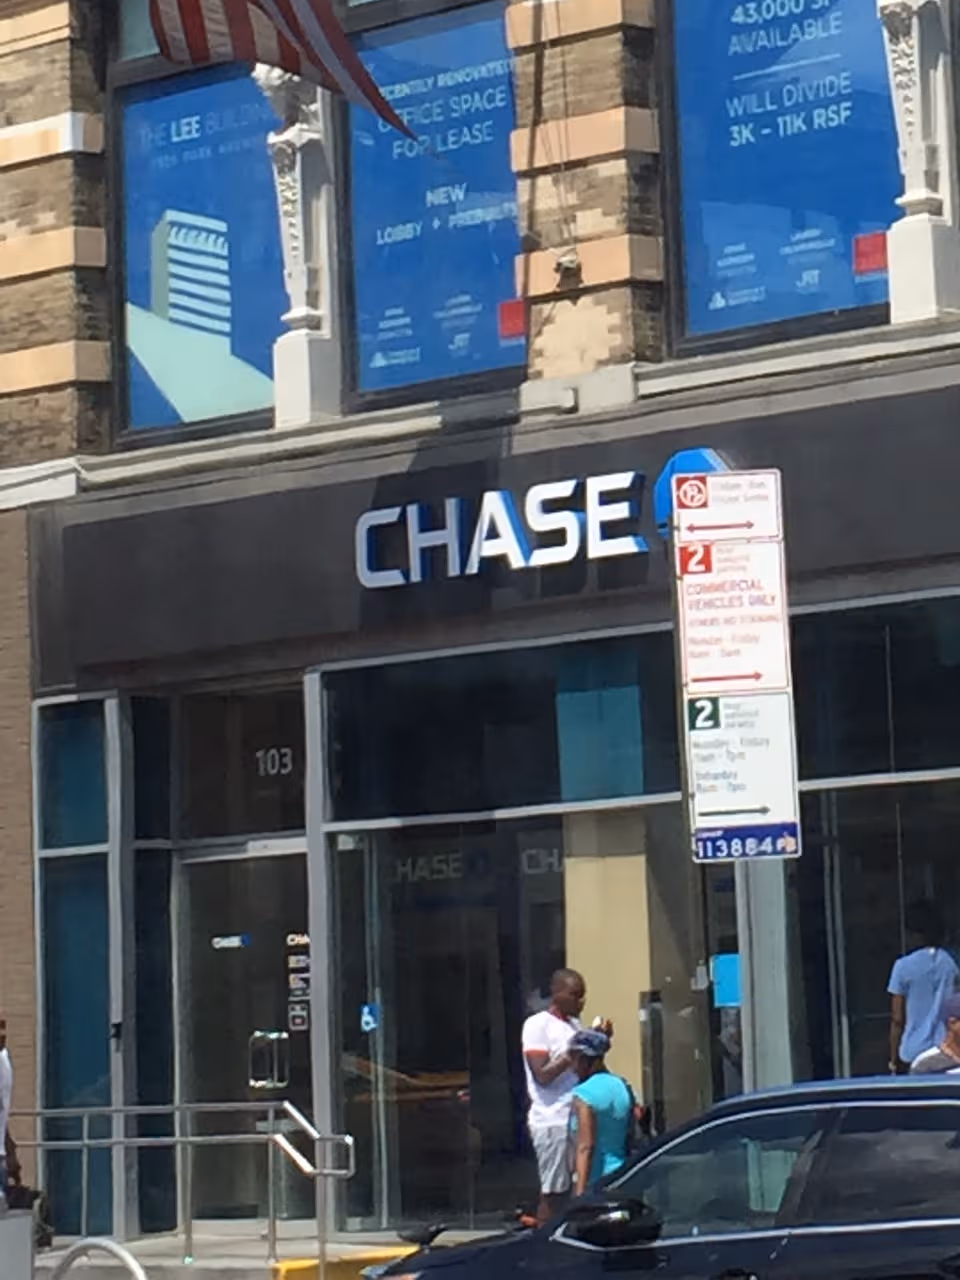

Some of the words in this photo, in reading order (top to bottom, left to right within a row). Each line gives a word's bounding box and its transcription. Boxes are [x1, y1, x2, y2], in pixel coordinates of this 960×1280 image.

[728, 11, 843, 57] AVAILABLE
[450, 85, 507, 118] SPACE
[726, 91, 778, 118] WILL
[783, 72, 853, 107] DIVIDE
[171, 115, 200, 142] LEE
[436, 120, 494, 151] LEASE
[729, 122, 756, 147] 3K
[813, 102, 853, 130] RSF
[426, 182, 467, 208] NEW
[355, 471, 648, 588] CHASE
[687, 543, 706, 572] 2
[695, 699, 715, 728] 2
[256, 748, 292, 776] 103
